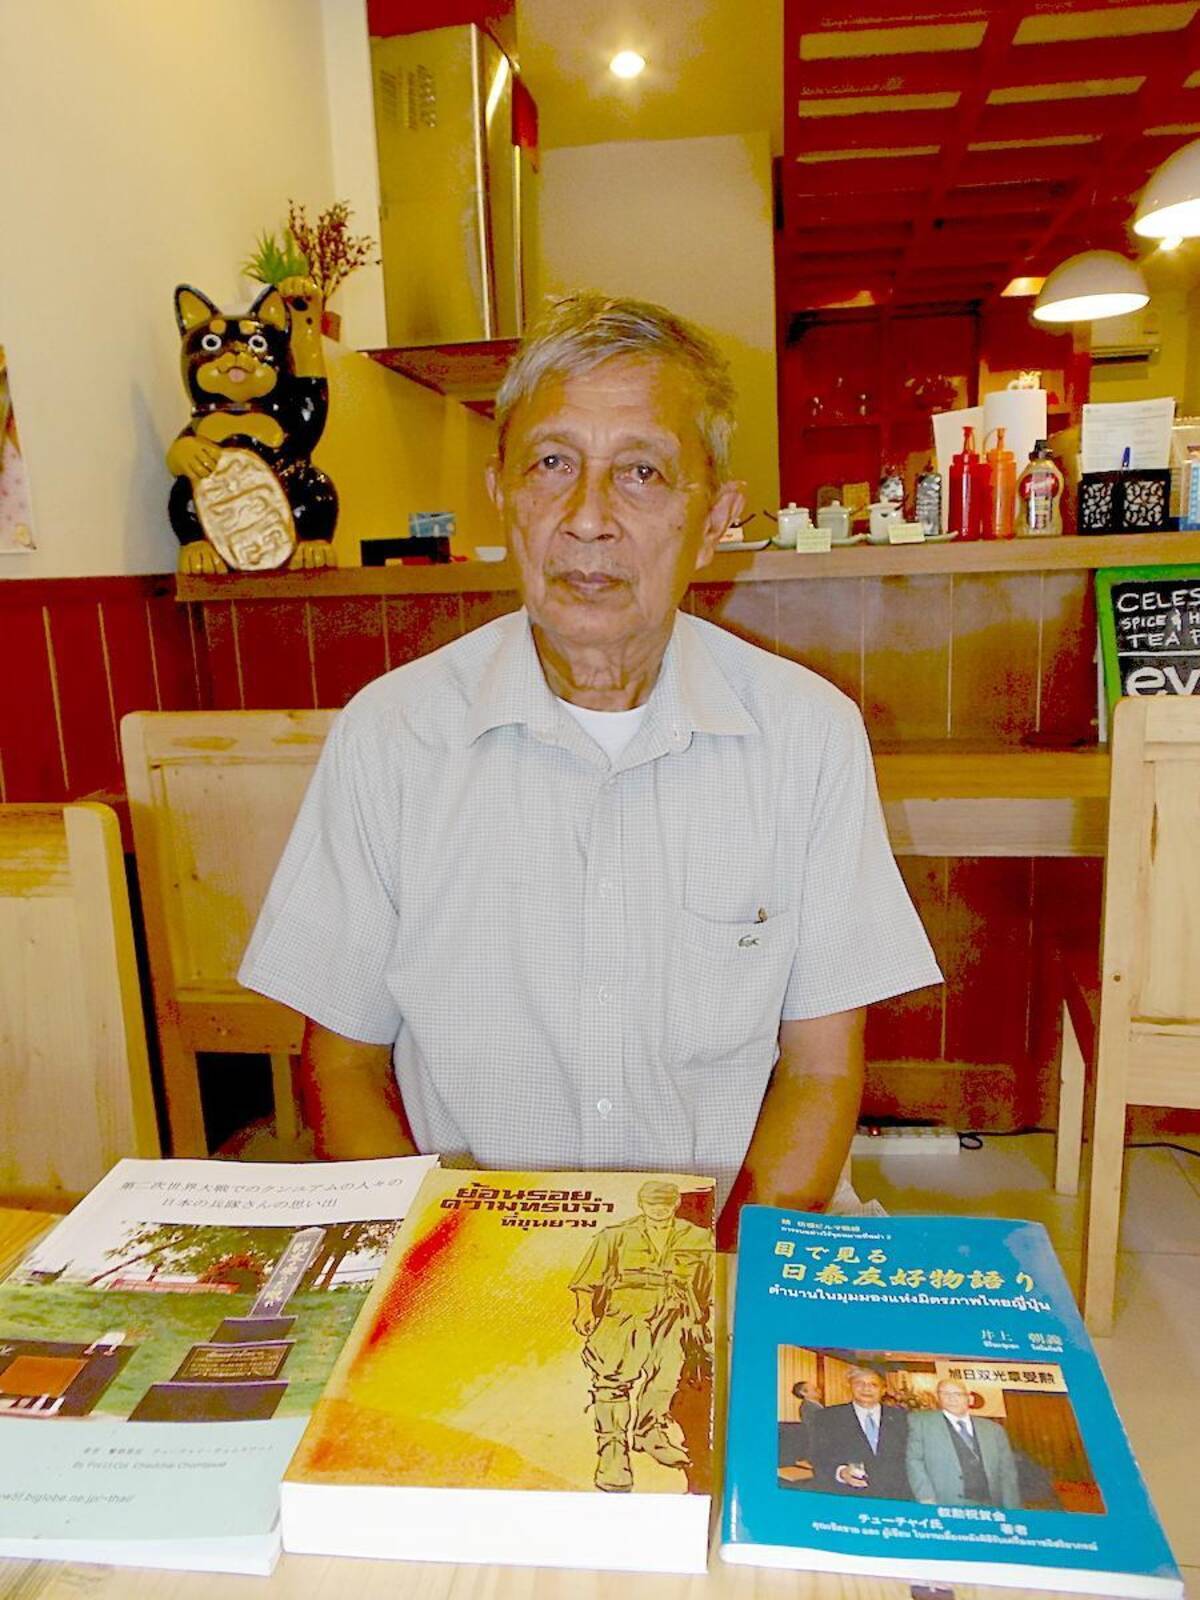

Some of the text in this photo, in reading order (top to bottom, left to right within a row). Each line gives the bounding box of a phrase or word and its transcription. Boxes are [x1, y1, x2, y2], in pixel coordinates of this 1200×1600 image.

[1120, 615, 1167, 630] SPICE
[1127, 632, 1180, 648] TEA
[456, 1183, 593, 1200] ย้อนรอย
[774, 1241, 888, 1264] 目で見る
[782, 1263, 1034, 1293] 日泰友好物語り
